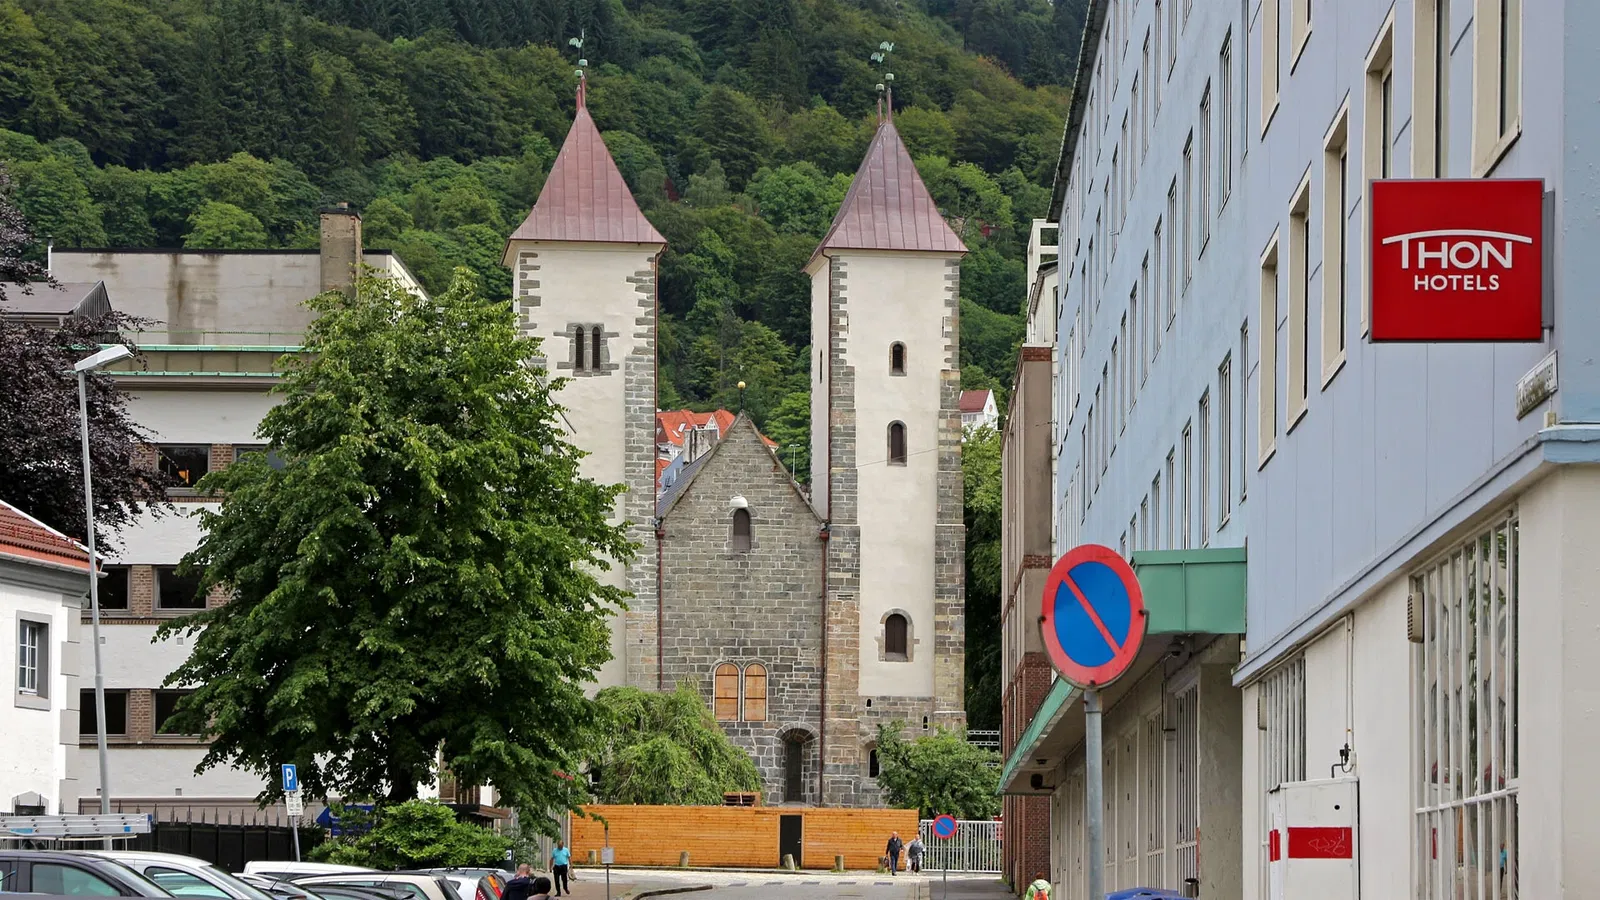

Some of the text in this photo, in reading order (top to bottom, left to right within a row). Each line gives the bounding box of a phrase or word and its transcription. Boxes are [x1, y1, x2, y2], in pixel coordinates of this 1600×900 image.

[1382, 229, 1533, 269] THON
[1414, 274, 1500, 291] HOTELS
[285, 767, 294, 788] P
